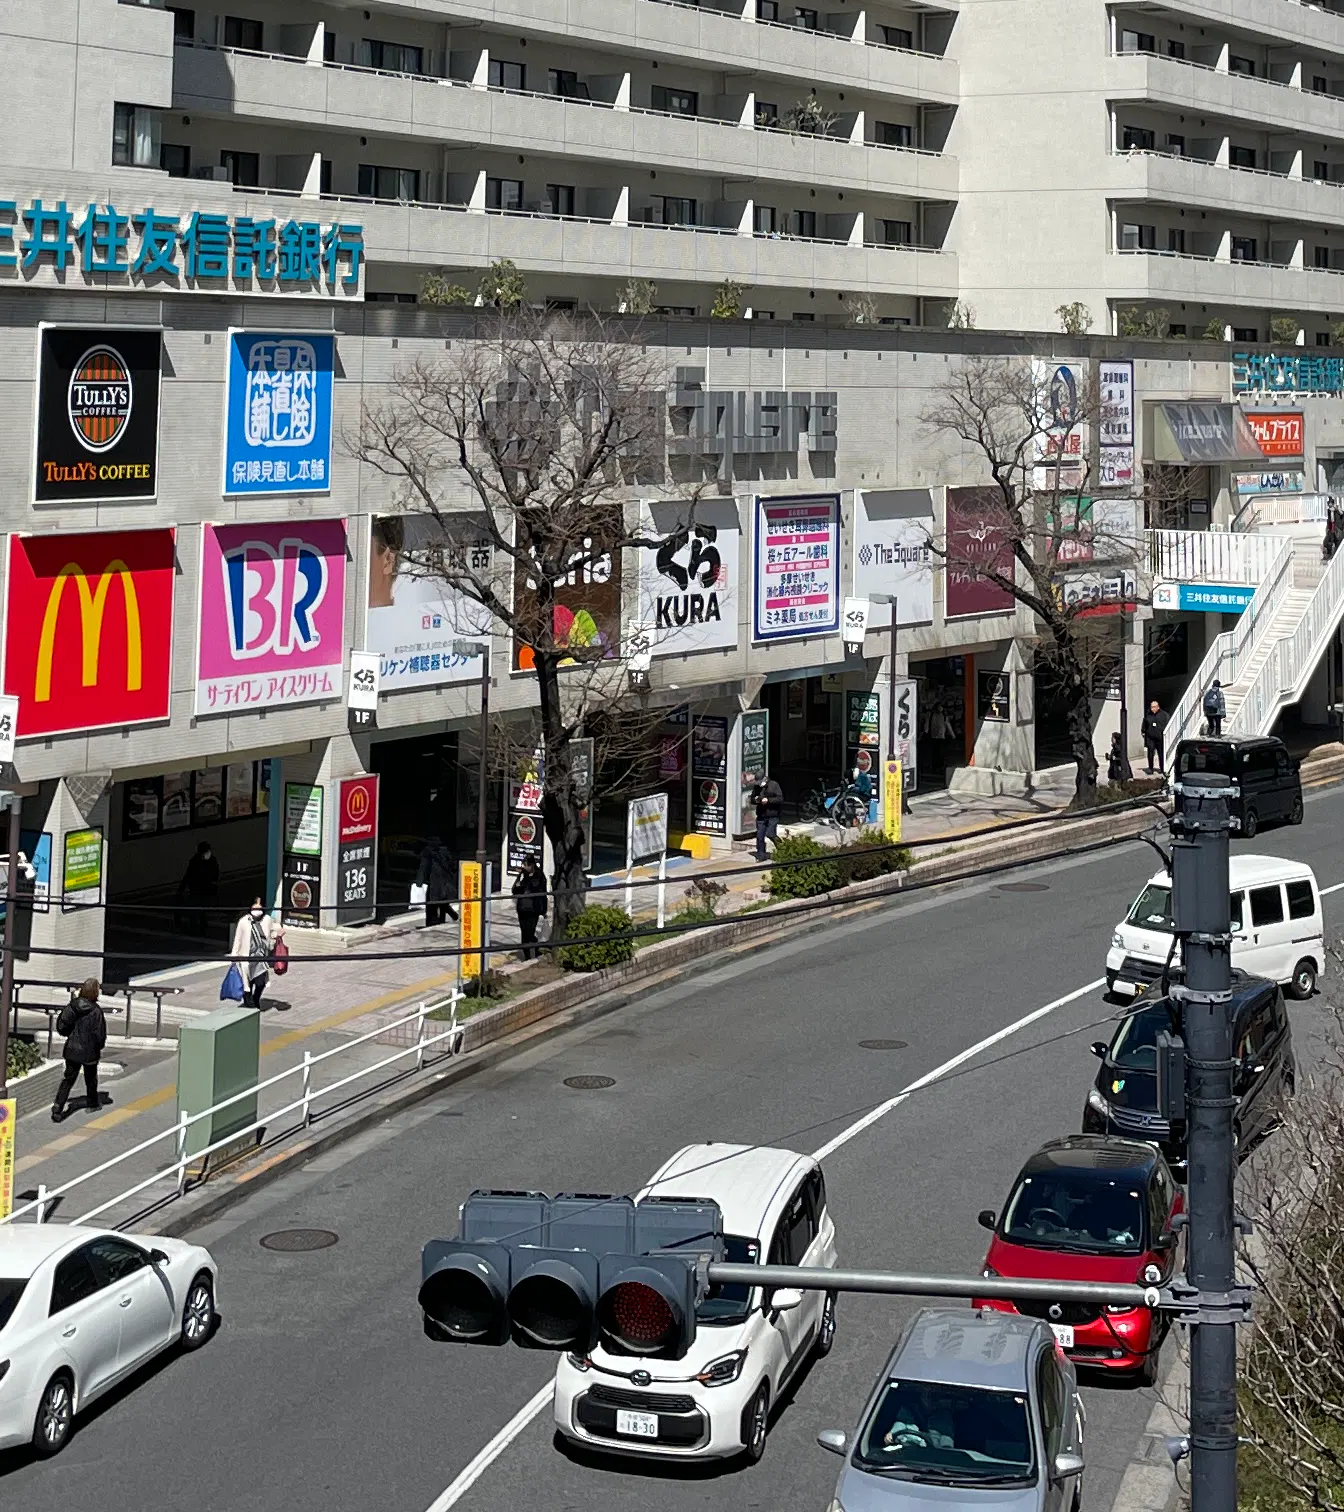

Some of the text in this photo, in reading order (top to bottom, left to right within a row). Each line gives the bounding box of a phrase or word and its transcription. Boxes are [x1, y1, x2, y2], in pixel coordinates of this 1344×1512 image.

[82, 407, 117, 416] COFFEE
[99, 463, 151, 480] COFFEE
[232, 459, 325, 484] 保険見直し本舗
[526, 538, 613, 591] ria
[657, 523, 722, 591] くら
[224, 542, 326, 655] BR
[657, 592, 721, 629] KURA
[846, 611, 864, 623] くら
[354, 668, 374, 684] くら
[208, 671, 333, 707] サーティワン アイスクリーム
[355, 710, 370, 724] 1F
[344, 867, 367, 889] 136
[344, 887, 367, 903] SEATS
[627, 1420, 655, 1435] 18-30
